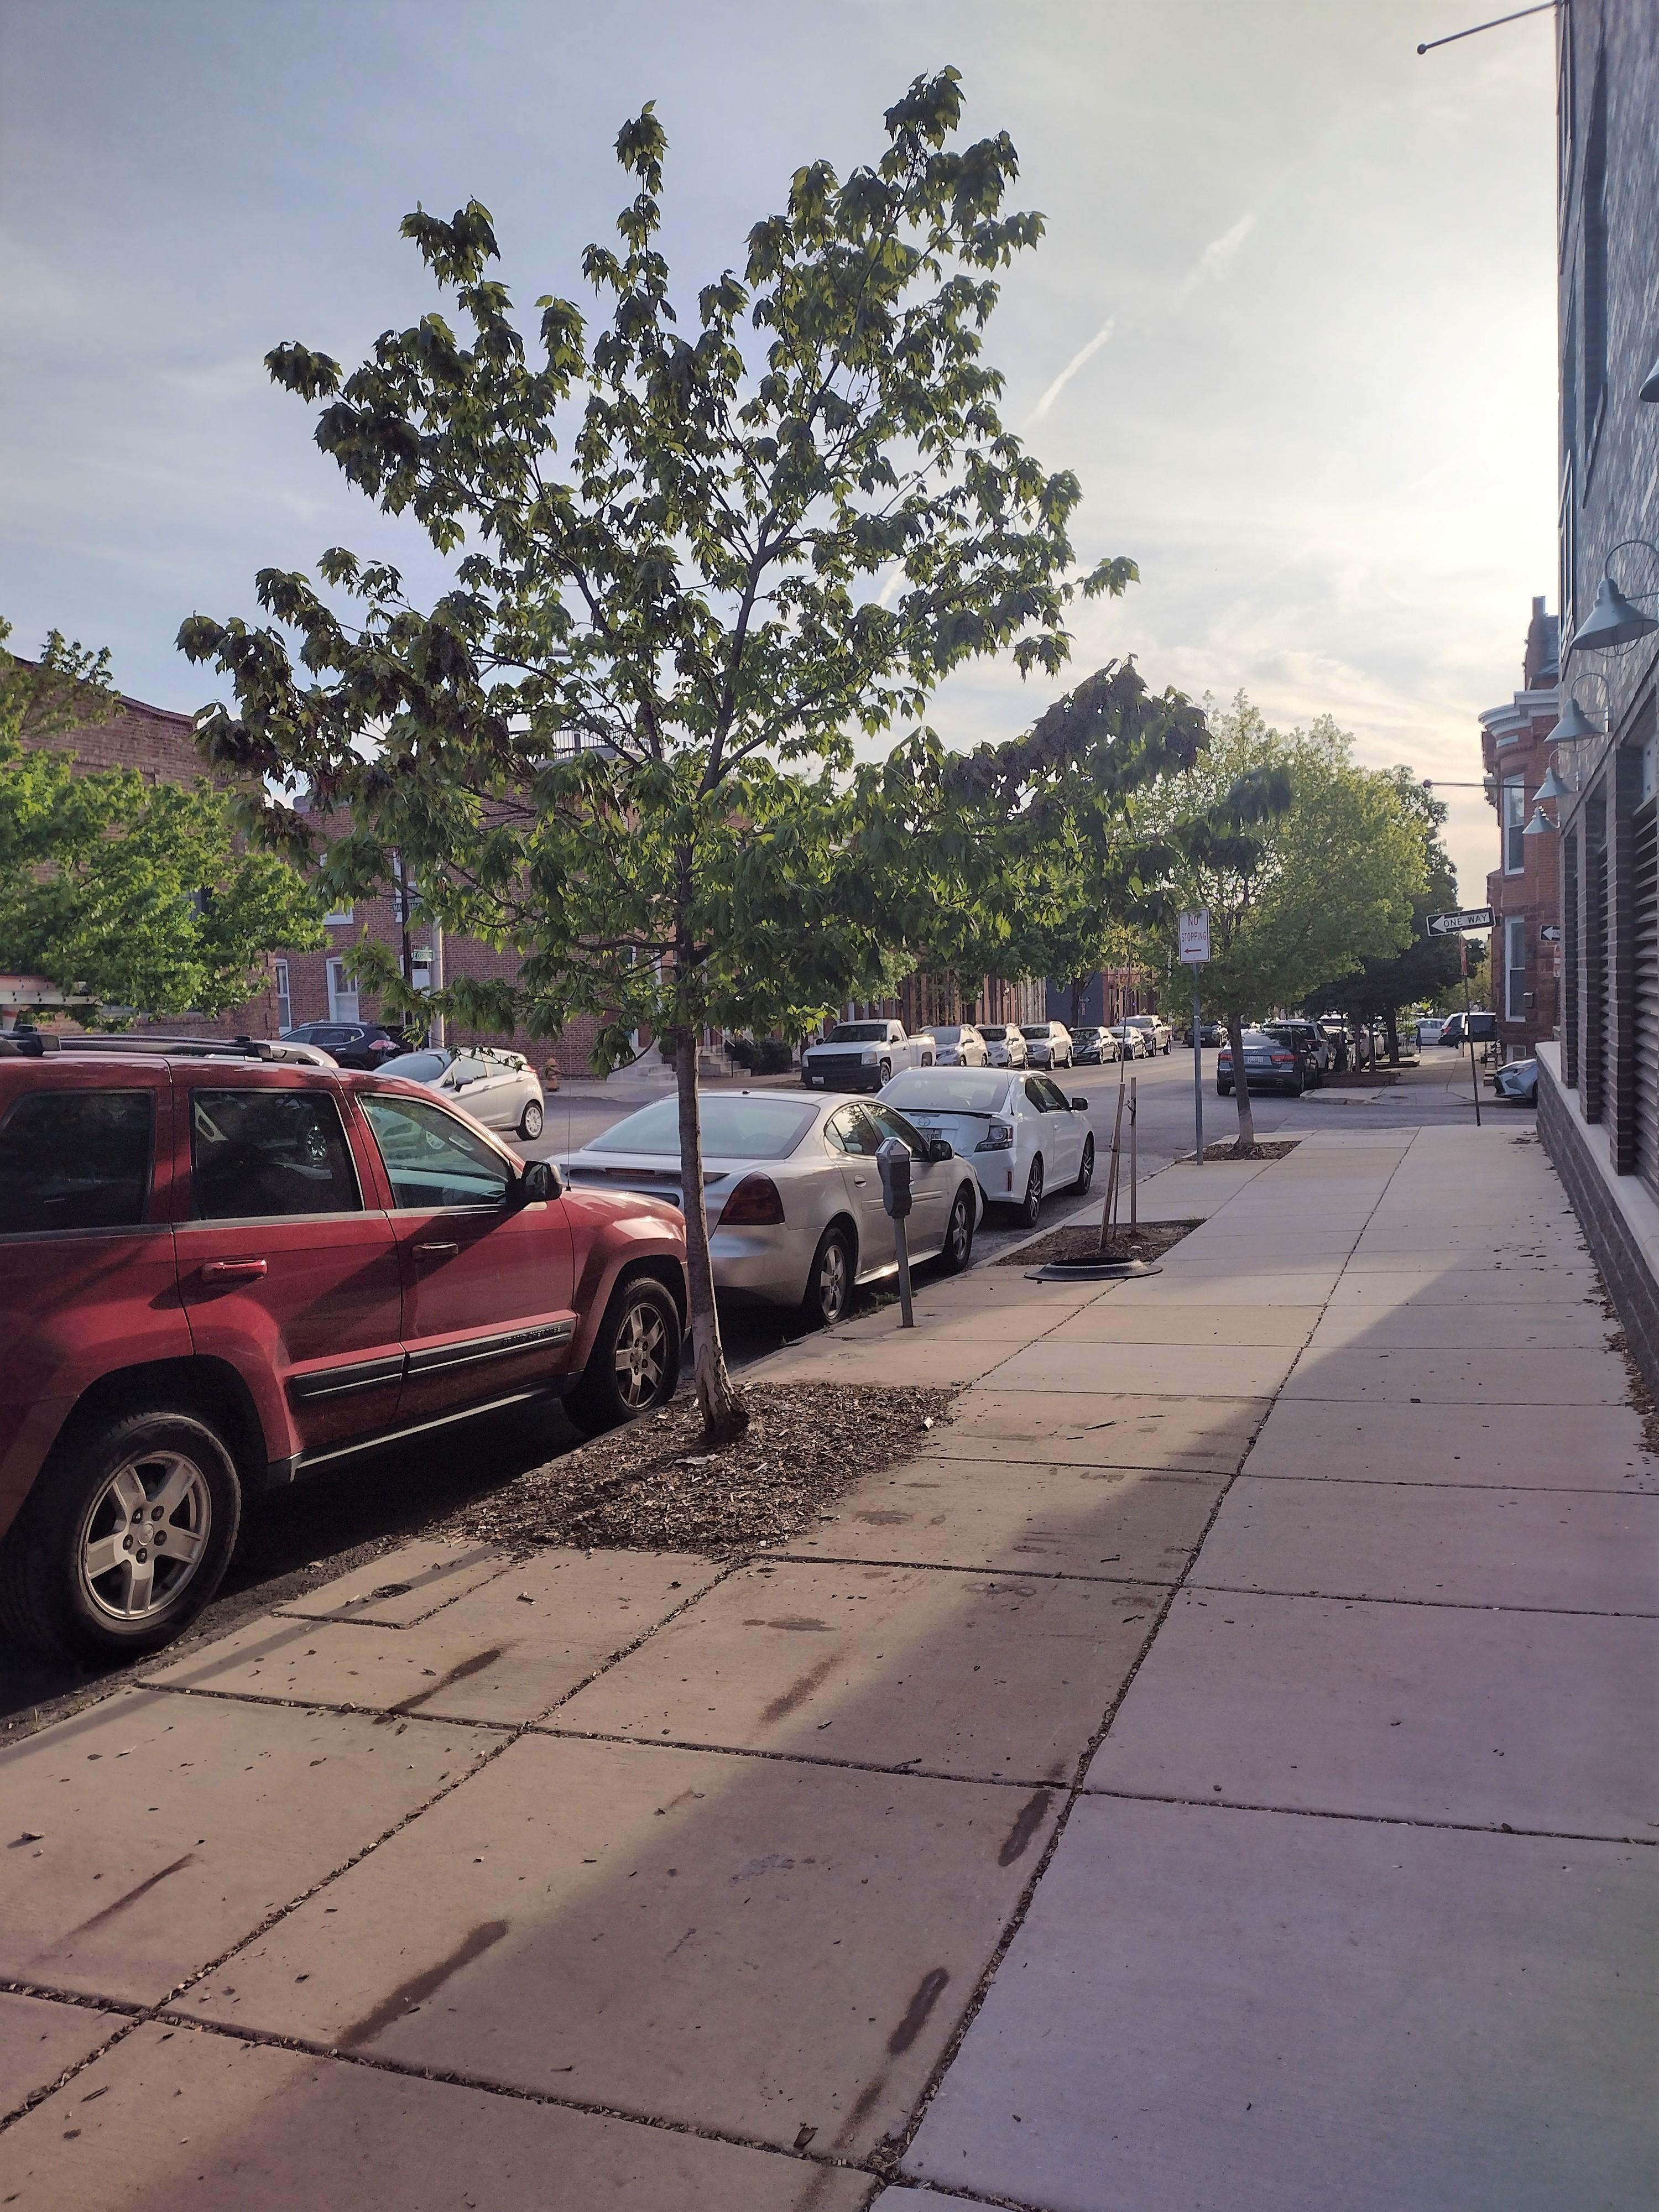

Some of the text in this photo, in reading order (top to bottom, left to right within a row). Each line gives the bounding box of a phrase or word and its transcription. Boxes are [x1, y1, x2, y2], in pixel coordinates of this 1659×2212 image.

[1188, 915, 1198, 926] NO
[1444, 914, 1488, 928] ONE WAY
[1181, 931, 1207, 942] STOPPING
